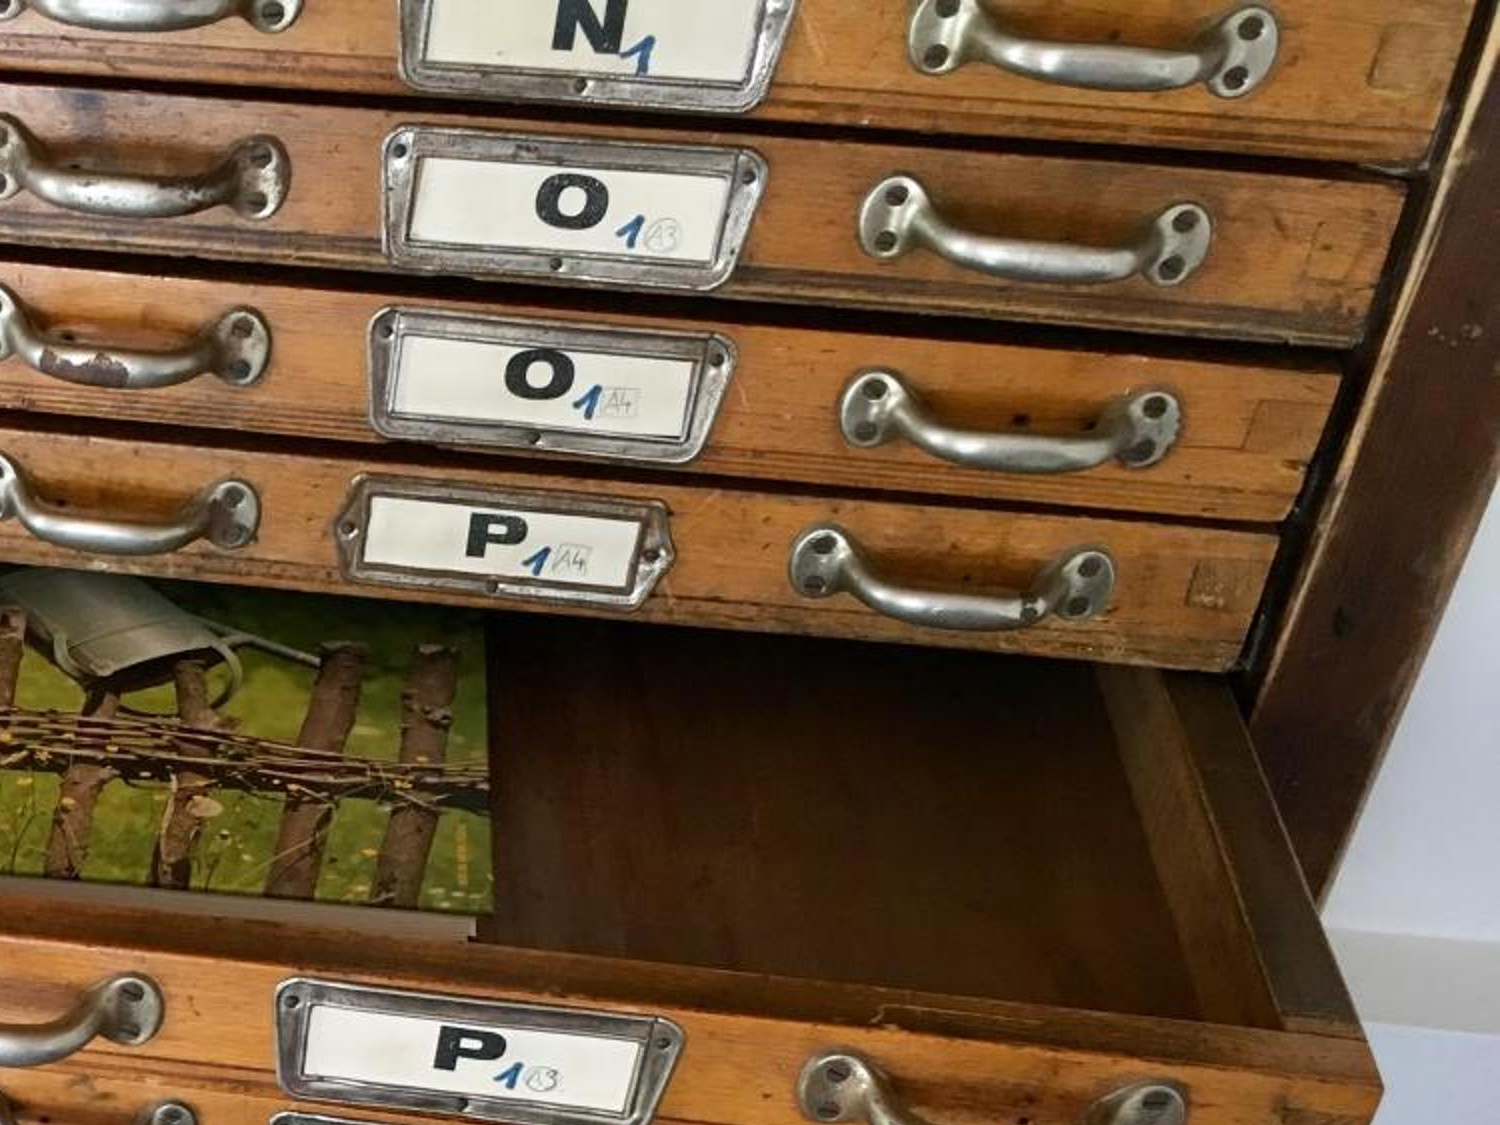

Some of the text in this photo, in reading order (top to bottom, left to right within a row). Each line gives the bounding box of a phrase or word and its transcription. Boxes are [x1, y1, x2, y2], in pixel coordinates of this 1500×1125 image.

[551, 0, 655, 75] N 1
[535, 173, 609, 230] O
[616, 215, 645, 248] 1
[505, 348, 576, 401] O
[573, 384, 603, 420] 1
[465, 512, 529, 558] P
[522, 546, 550, 576] 1
[433, 1025, 507, 1072] P
[493, 1061, 524, 1090] 1
